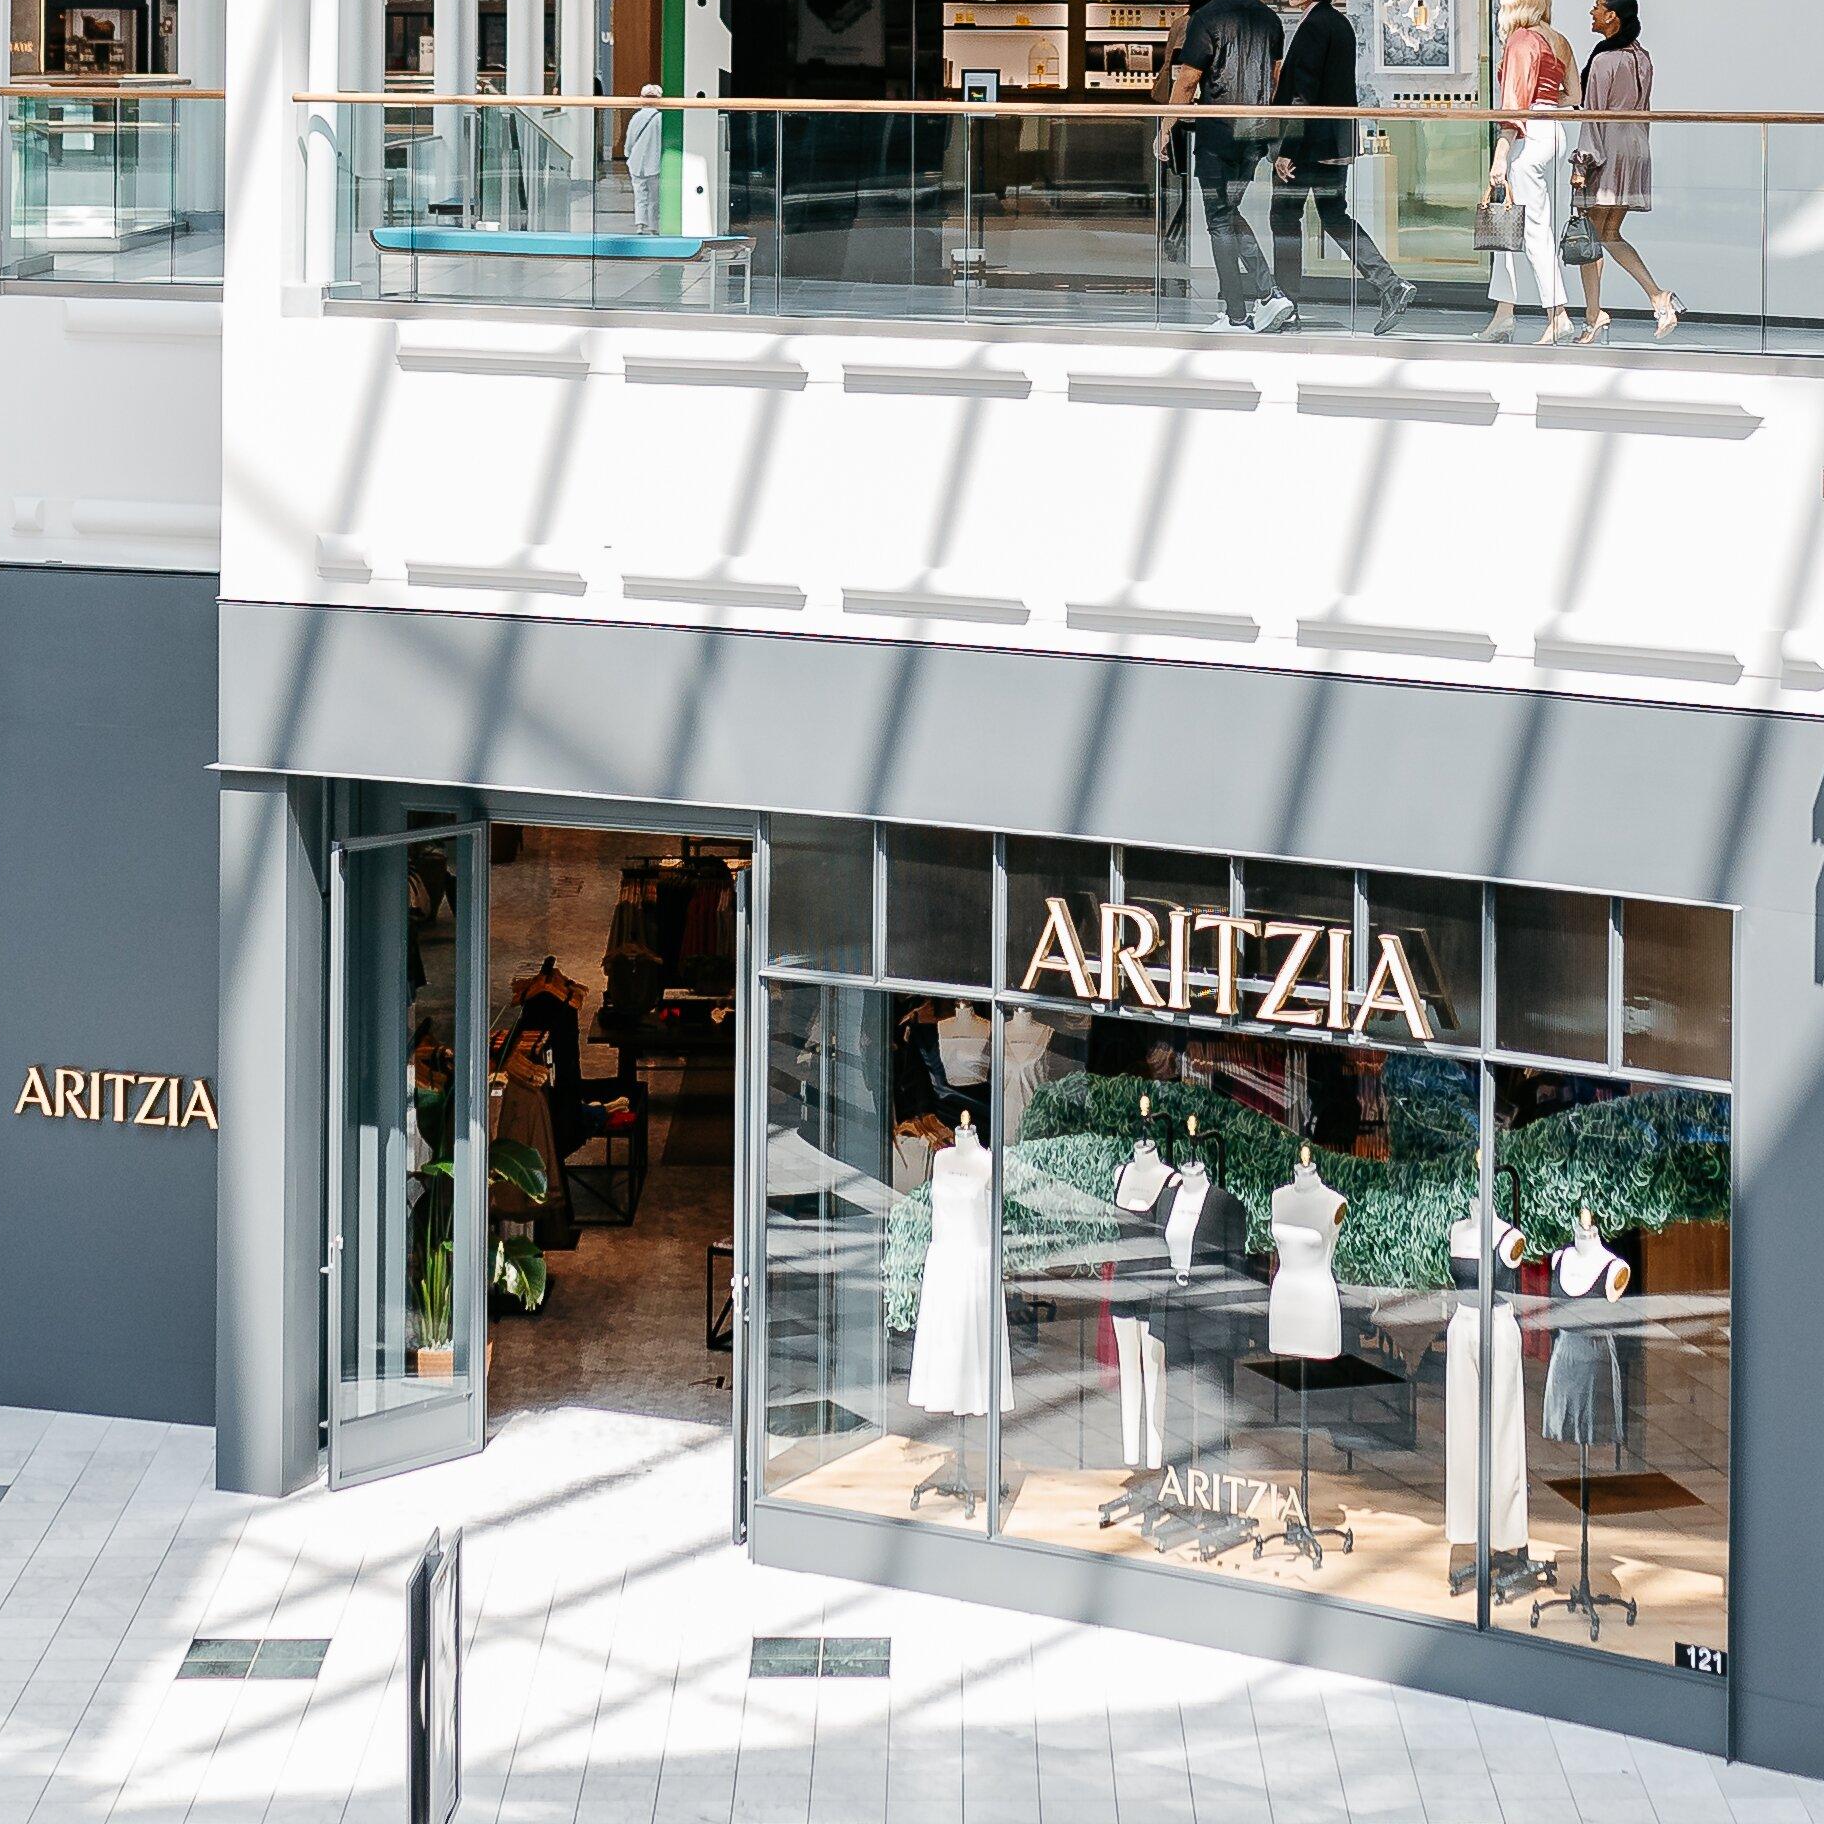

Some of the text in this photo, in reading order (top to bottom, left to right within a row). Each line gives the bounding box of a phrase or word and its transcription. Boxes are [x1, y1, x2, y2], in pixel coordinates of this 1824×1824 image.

[1020, 897, 1435, 1040] ARITZIA
[14, 1064, 219, 1129] ARITZIA
[1158, 1464, 1308, 1527] ARITZIA
[1686, 1644, 1722, 1675] 121
